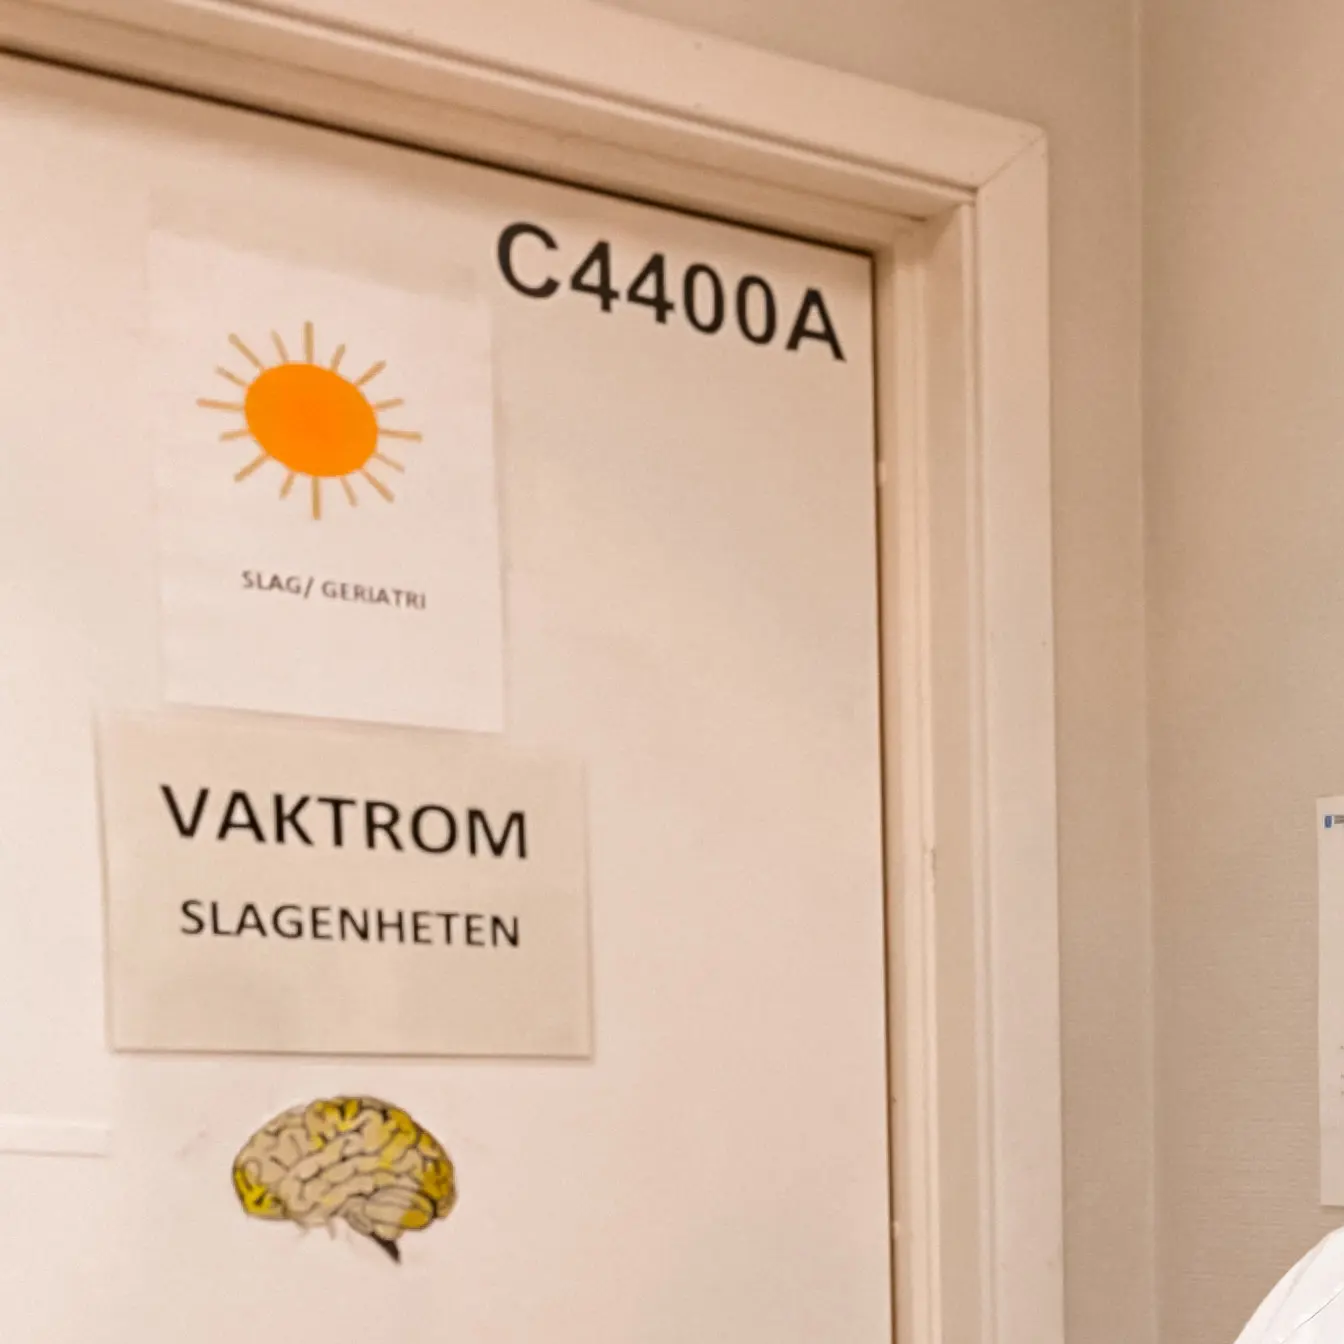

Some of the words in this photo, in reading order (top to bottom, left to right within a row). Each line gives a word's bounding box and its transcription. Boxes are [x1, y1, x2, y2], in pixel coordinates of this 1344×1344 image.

[497, 221, 847, 362] C4400A
[241, 570, 315, 599] SLAG/
[321, 580, 427, 610] GERIATRI
[160, 784, 528, 860] VAKTROM
[181, 899, 520, 948] SLAGENHETEN
